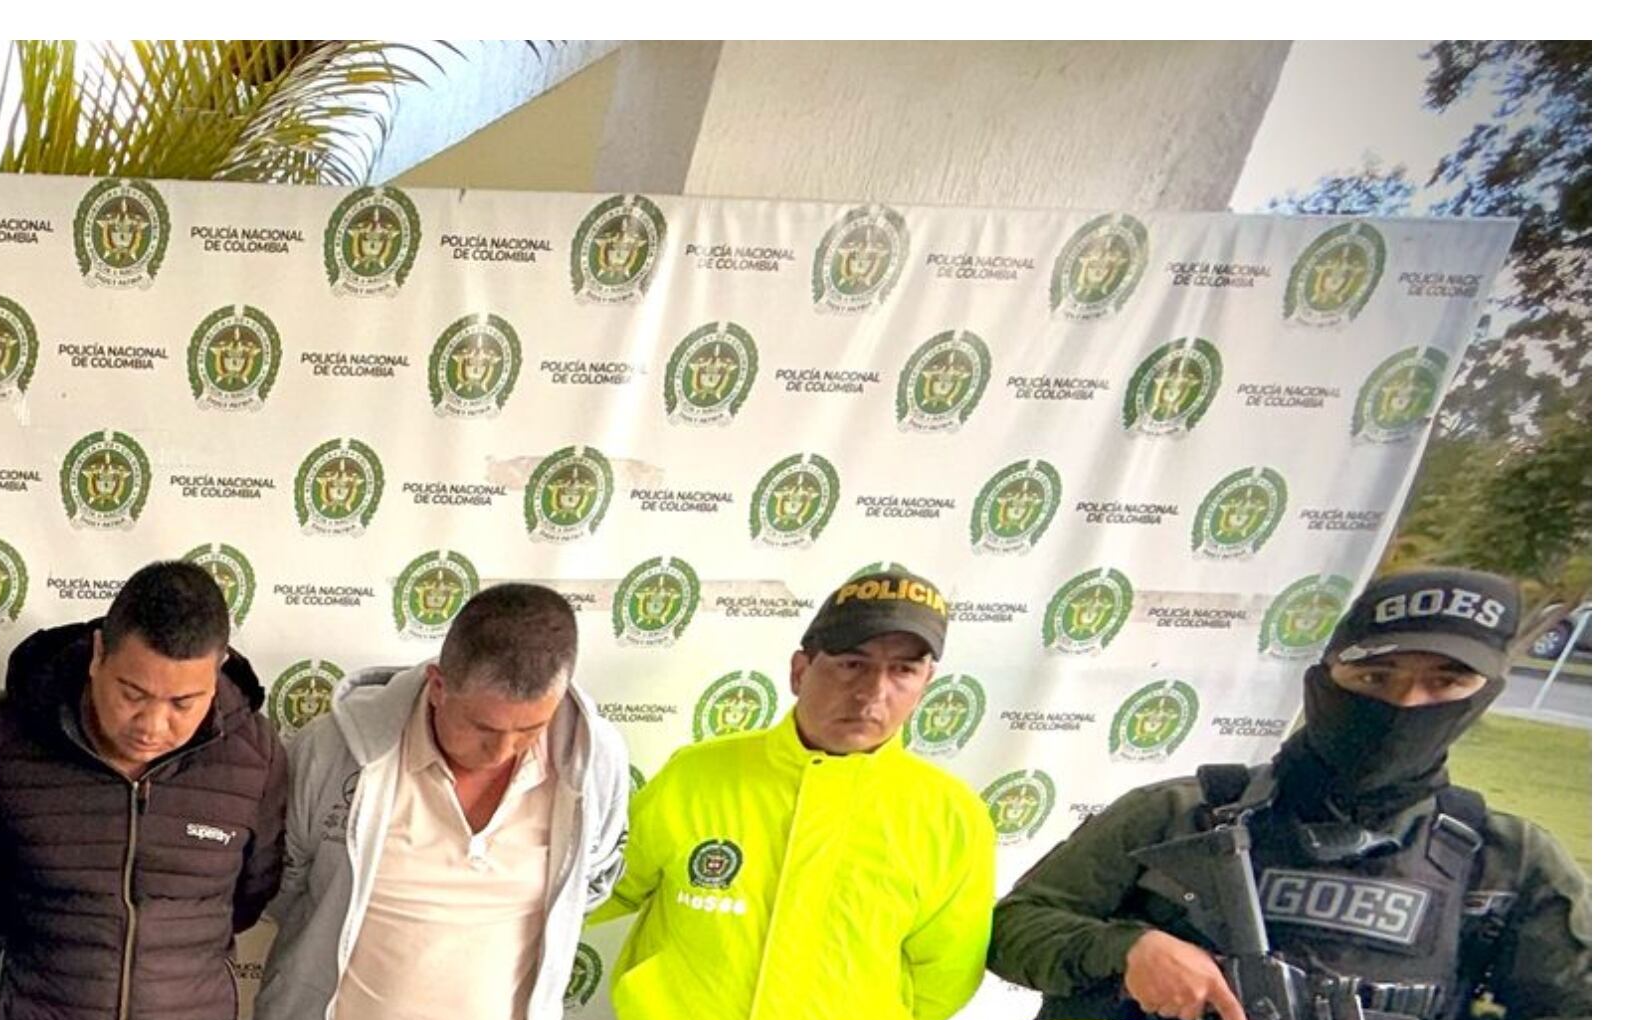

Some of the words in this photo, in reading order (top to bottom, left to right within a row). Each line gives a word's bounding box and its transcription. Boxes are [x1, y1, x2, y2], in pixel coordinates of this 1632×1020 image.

[191, 226, 239, 240] POLICÍA
[241, 228, 304, 242] NACIONAL
[204, 239, 221, 251] DE
[223, 240, 289, 253] COLOMBIA
[440, 234, 488, 249] POLICÍA
[490, 238, 552, 251] NACIONAL
[453, 248, 470, 260] DE
[472, 248, 536, 262] COLOMBIA
[58, 343, 106, 357] POLICÍA
[107, 346, 168, 359] NACIONAL
[72, 356, 88, 368] DE
[90, 357, 154, 369] COLOMBIA
[300, 352, 347, 365] POLICÍA
[350, 354, 410, 366] NACIONAL
[314, 364, 330, 376] DE
[332, 365, 394, 377] COLOMBIA
[824, 371, 880, 383] NACIONAL
[786, 380, 802, 392] DE
[805, 381, 864, 393] COLOMBIA
[1053, 378, 1108, 390] NACIONAL
[1016, 388, 1032, 398] DE
[1034, 388, 1094, 400] COLOMBIA
[1284, 386, 1340, 398] NACIONAL
[1246, 395, 1262, 406] DE
[1264, 396, 1323, 408] COLOMBIA
[170, 474, 215, 486] POLICÍA
[217, 477, 276, 488] NACIONAL
[182, 486, 198, 497] DE
[200, 487, 261, 498] COLOMBIA
[402, 482, 448, 494] POLICÍA
[450, 484, 506, 496] NACIONAL
[630, 489, 674, 500] POLICÍA
[676, 491, 733, 502] NACIONAL
[414, 493, 430, 504] DE
[432, 494, 492, 505] COLOMBIA
[856, 496, 898, 507] POLICÍA
[901, 498, 955, 509] NACIONAL
[641, 501, 657, 511] DE
[659, 501, 718, 512] COLOMBIA
[866, 506, 881, 517] DE
[883, 507, 940, 518] COLOMBIA
[1124, 504, 1178, 515] NACIONAL
[1086, 512, 1104, 523] DE
[1106, 513, 1161, 524] COLOMBIA
[48, 578, 90, 589] POLICÍA
[95, 580, 125, 590] NACIO
[274, 584, 316, 596] POLICÍA
[318, 586, 375, 597] NACIONAL
[60, 589, 74, 599] DE
[77, 590, 118, 599] COLOM
[285, 595, 300, 605] DE
[302, 596, 360, 606] COLOMBIA
[1192, 609, 1246, 620] NACIONAL
[1375, 589, 1505, 628] GOES
[1157, 618, 1173, 627] DE
[1174, 618, 1231, 628] COLOMBIA
[1268, 875, 1413, 935] GOES
